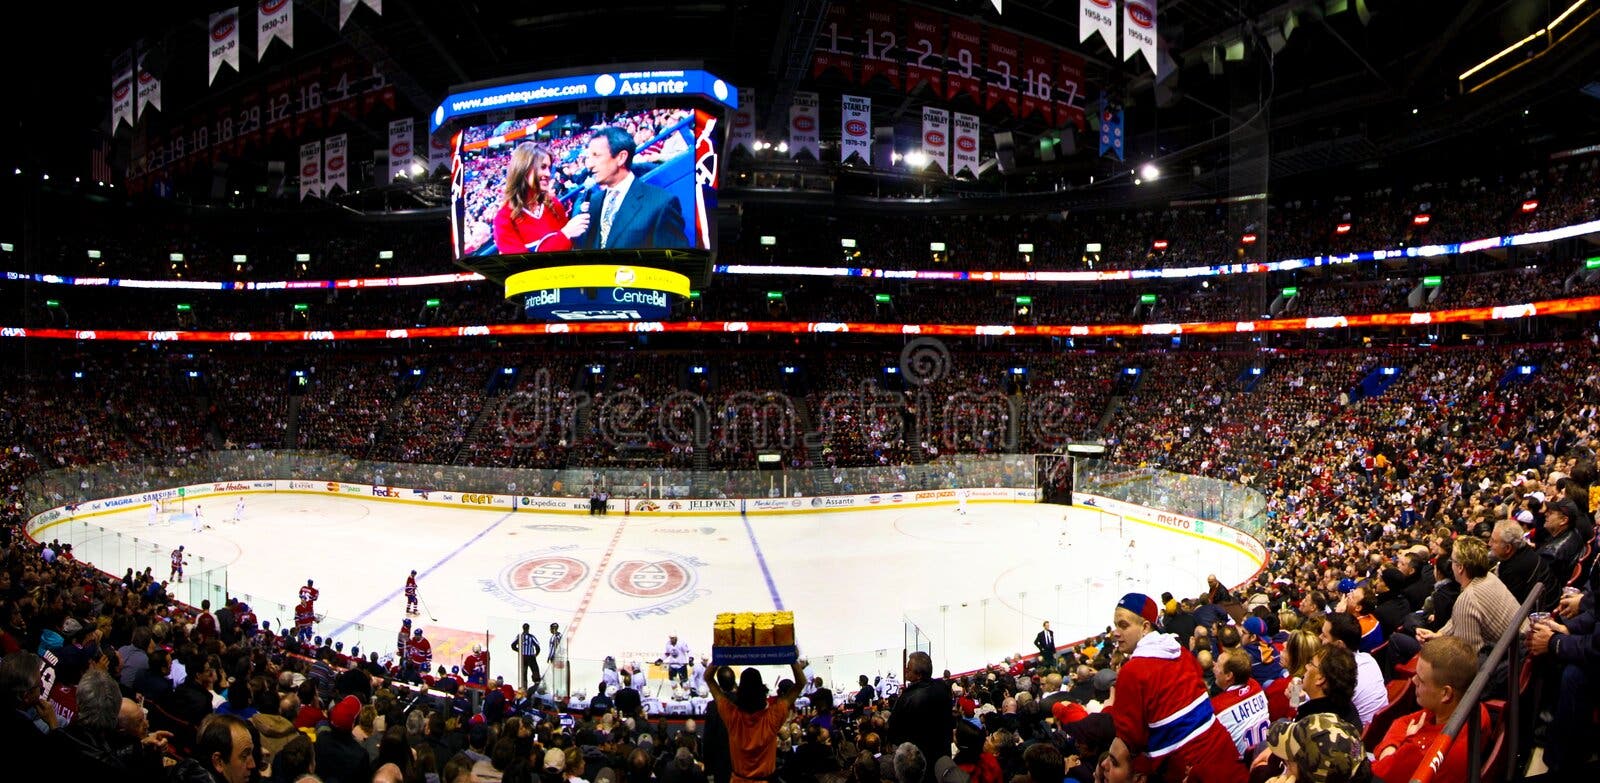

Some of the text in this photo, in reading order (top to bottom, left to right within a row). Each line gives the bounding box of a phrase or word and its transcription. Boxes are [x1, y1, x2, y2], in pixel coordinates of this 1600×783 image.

[262, 13, 288, 32] 1930-31
[1085, 8, 1112, 26] 1958-59
[864, 28, 896, 62] 12
[1128, 28, 1153, 45] 1959-60
[212, 40, 235, 58] 1929-30
[917, 39, 933, 70] 2
[958, 48, 972, 78] 9
[996, 60, 1011, 90] 3
[336, 72, 350, 99] 4
[619, 80, 685, 95] Assante
[1023, 69, 1051, 100] 16
[1065, 80, 1078, 106] 7
[298, 81, 321, 113] 16
[452, 84, 588, 111] www.assantequebec.com
[266, 93, 292, 124] 12
[843, 103, 869, 112] STANLEY
[239, 105, 261, 136] 29
[923, 114, 948, 125] STANLEY
[955, 120, 978, 131] STANLEY
[216, 117, 233, 144] 18
[390, 125, 412, 135] STANLEY
[169, 136, 185, 163] 19
[301, 147, 320, 157] STANLEY
[326, 140, 346, 151] STANLEY
[142, 489, 177, 502] SAMSUNG
[225, 482, 251, 491] Hortons
[372, 485, 400, 498] FedEx
[915, 490, 956, 501] pizza pizza
[104, 498, 134, 508] VIAGRA
[530, 499, 567, 507] Expedia.ca
[1156, 513, 1190, 529] metro
